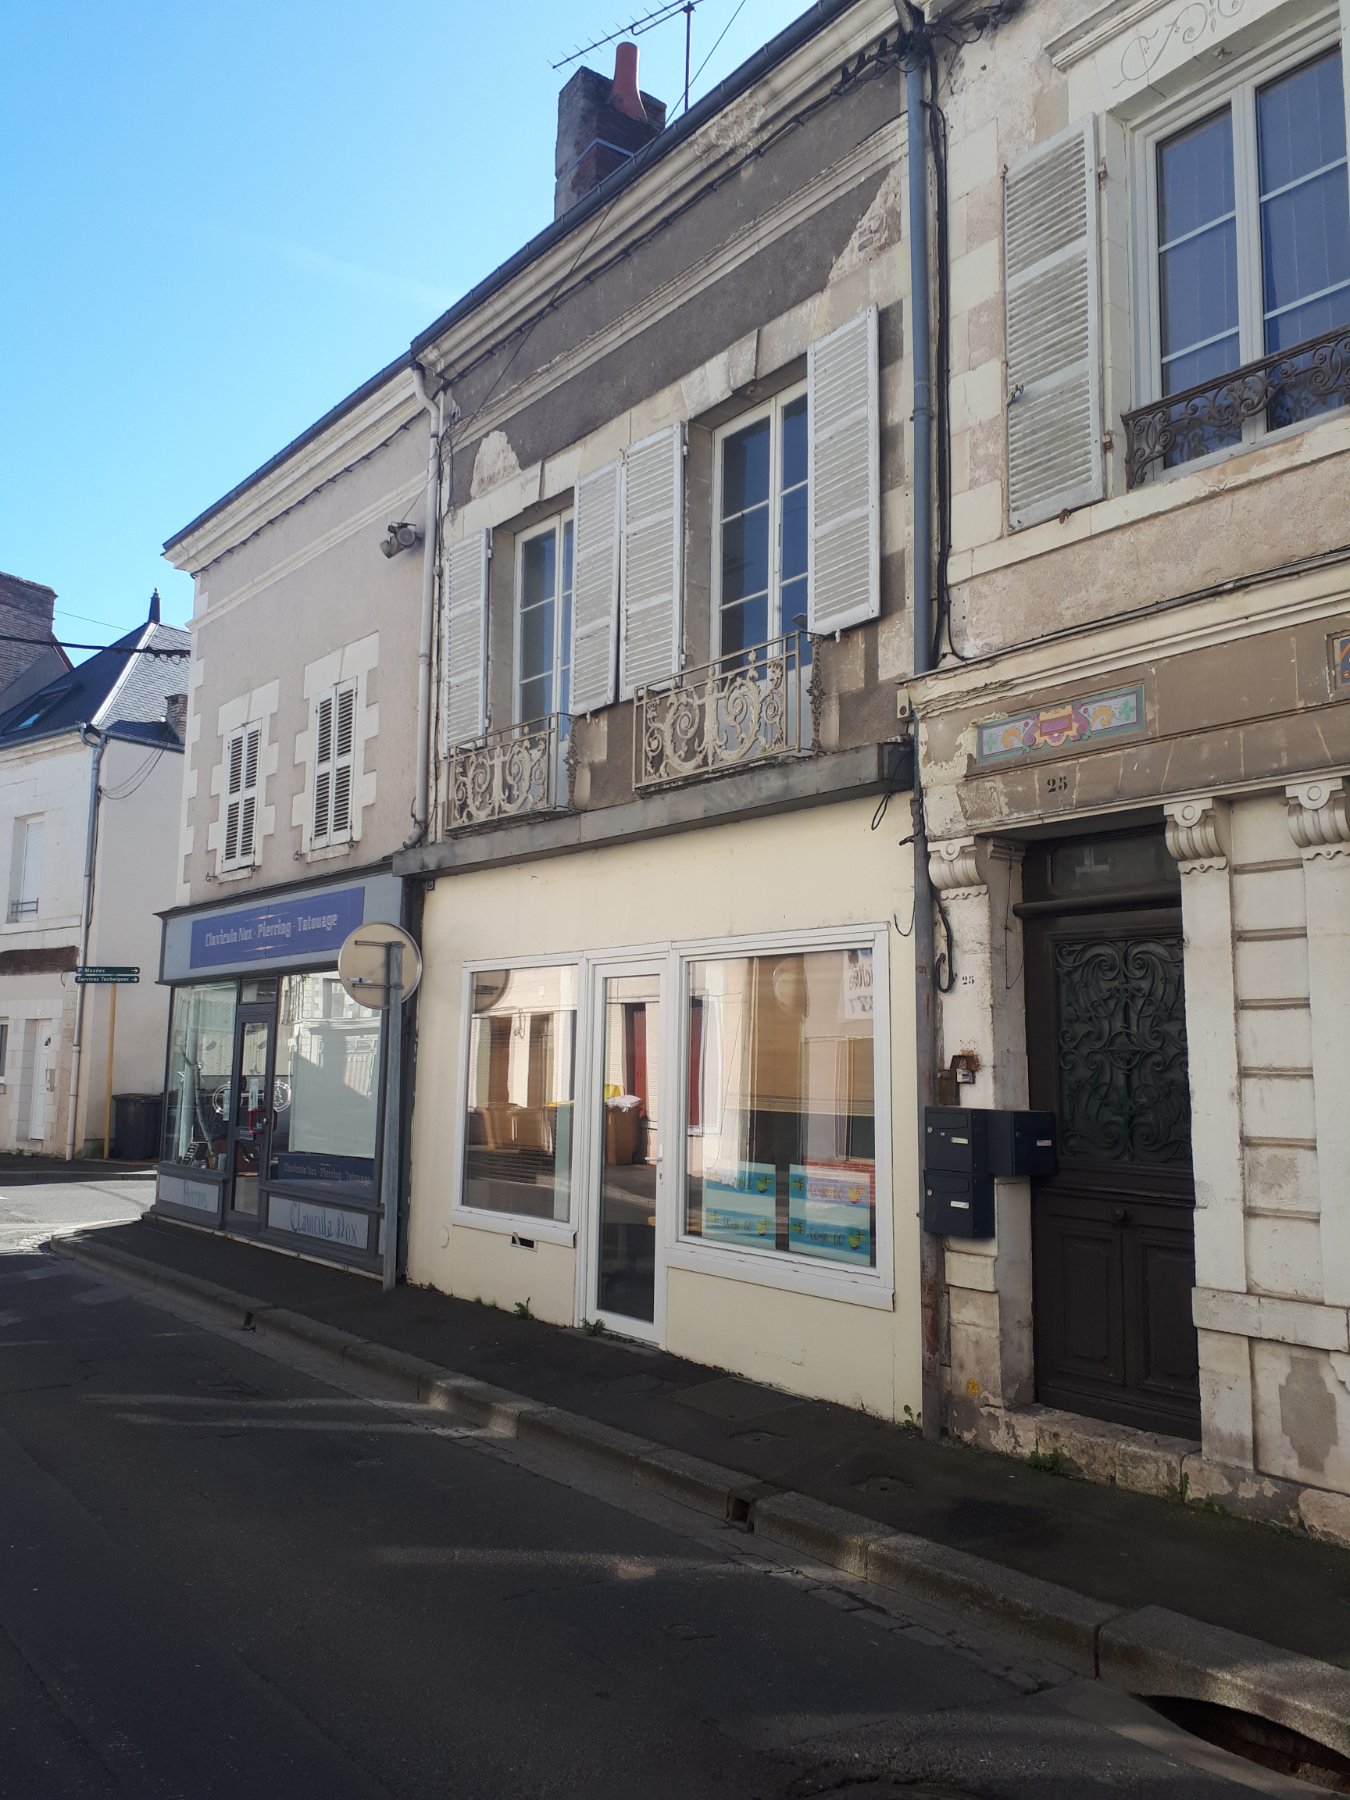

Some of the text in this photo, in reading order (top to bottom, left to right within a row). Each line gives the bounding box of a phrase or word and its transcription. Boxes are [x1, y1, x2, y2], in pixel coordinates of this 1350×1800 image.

[1047, 776, 1067, 793] 25
[297, 914, 338, 932] Tatouage
[962, 975, 975, 985] 25
